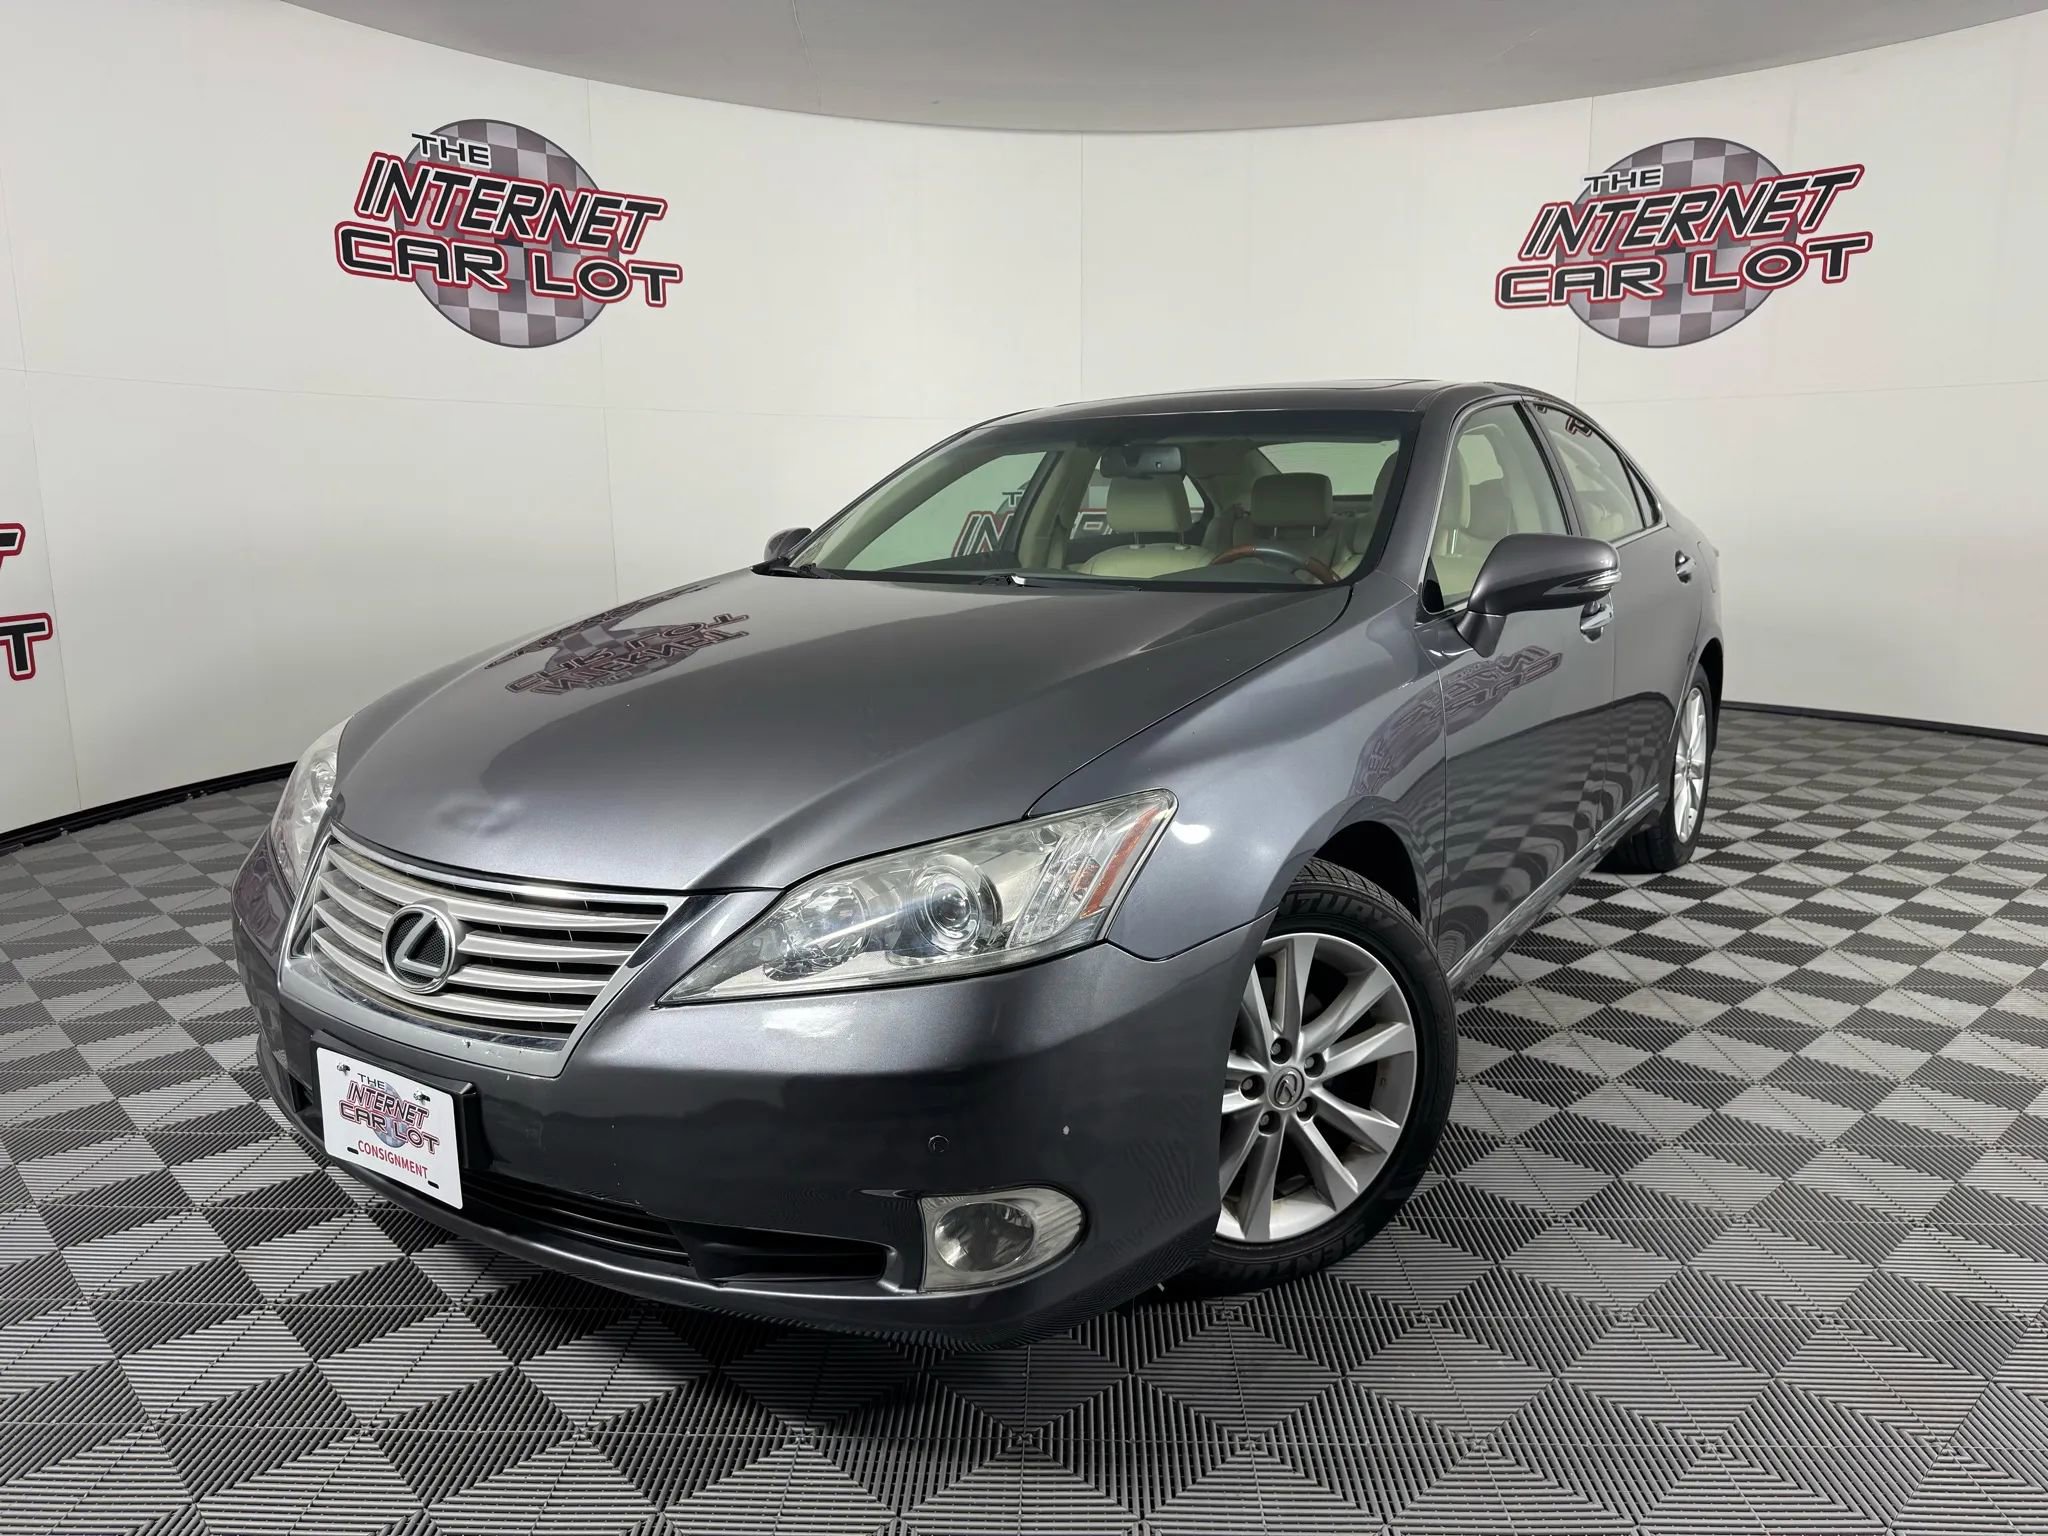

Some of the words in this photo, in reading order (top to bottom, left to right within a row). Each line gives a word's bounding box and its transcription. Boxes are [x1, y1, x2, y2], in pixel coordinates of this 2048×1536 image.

[411, 131, 491, 168] THE
[354, 151, 668, 253] INTERNET
[1583, 165, 1664, 194] THE
[1518, 163, 1865, 261] INTERNET
[335, 221, 511, 291] CAR
[528, 249, 683, 308] LOT
[1495, 256, 1666, 309] CAR
[1689, 231, 1873, 296] LOT
[347, 1080, 430, 1129] INTERNET
[357, 1073, 386, 1089] THE
[338, 1100, 388, 1134] CAR
[393, 1120, 440, 1155] LOT
[357, 1140, 428, 1179] CONSIGNMENT
